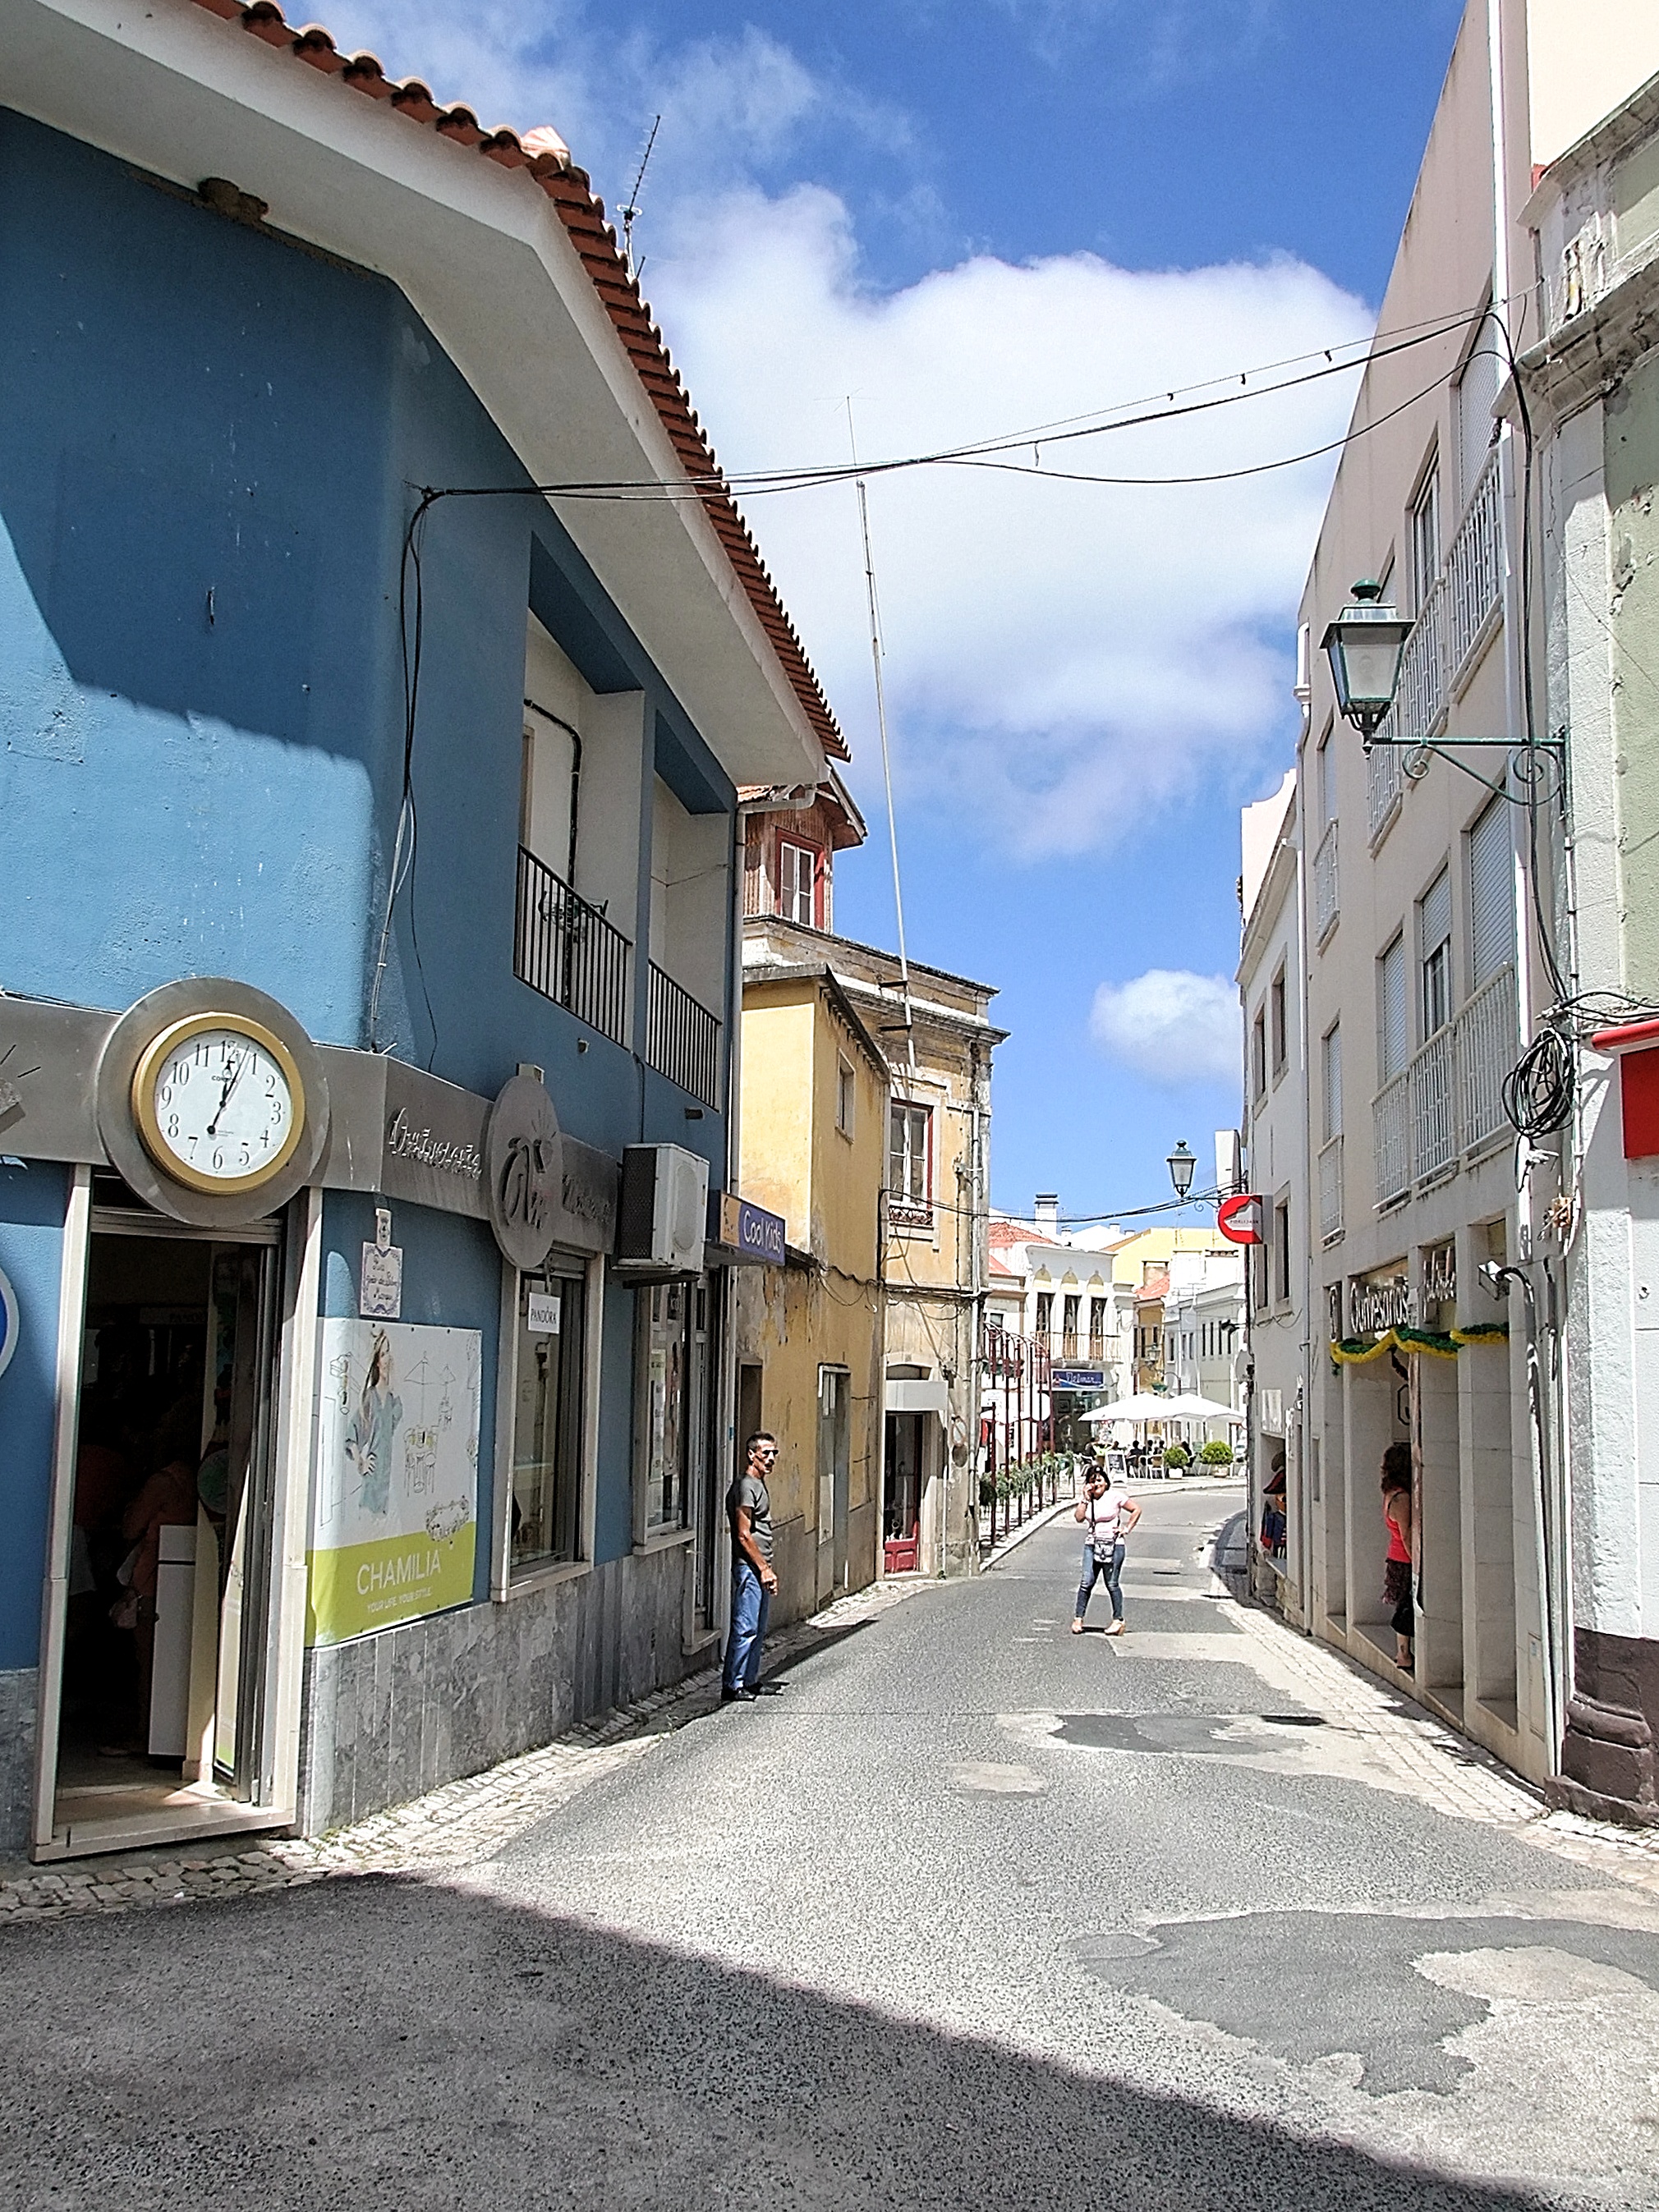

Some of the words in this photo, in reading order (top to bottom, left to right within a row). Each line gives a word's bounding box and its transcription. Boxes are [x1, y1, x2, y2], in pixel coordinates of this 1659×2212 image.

[195, 1043, 209, 1067] 11
[221, 1039, 241, 1065] 12
[171, 1061, 190, 1085] 10
[251, 1053, 258, 1076] 1
[161, 1085, 172, 1110] 9
[264, 1074, 276, 1098] 2
[270, 1101, 282, 1125] 3
[168, 1113, 179, 1138] 8
[187, 1136, 199, 1160] 7
[260, 1127, 270, 1149] 4
[212, 1145, 223, 1170] 6
[238, 1142, 250, 1166] 5
[743, 1209, 765, 1246] Cool
[765, 1220, 783, 1255] Kids
[357, 1549, 441, 1595] CHAMILIA
